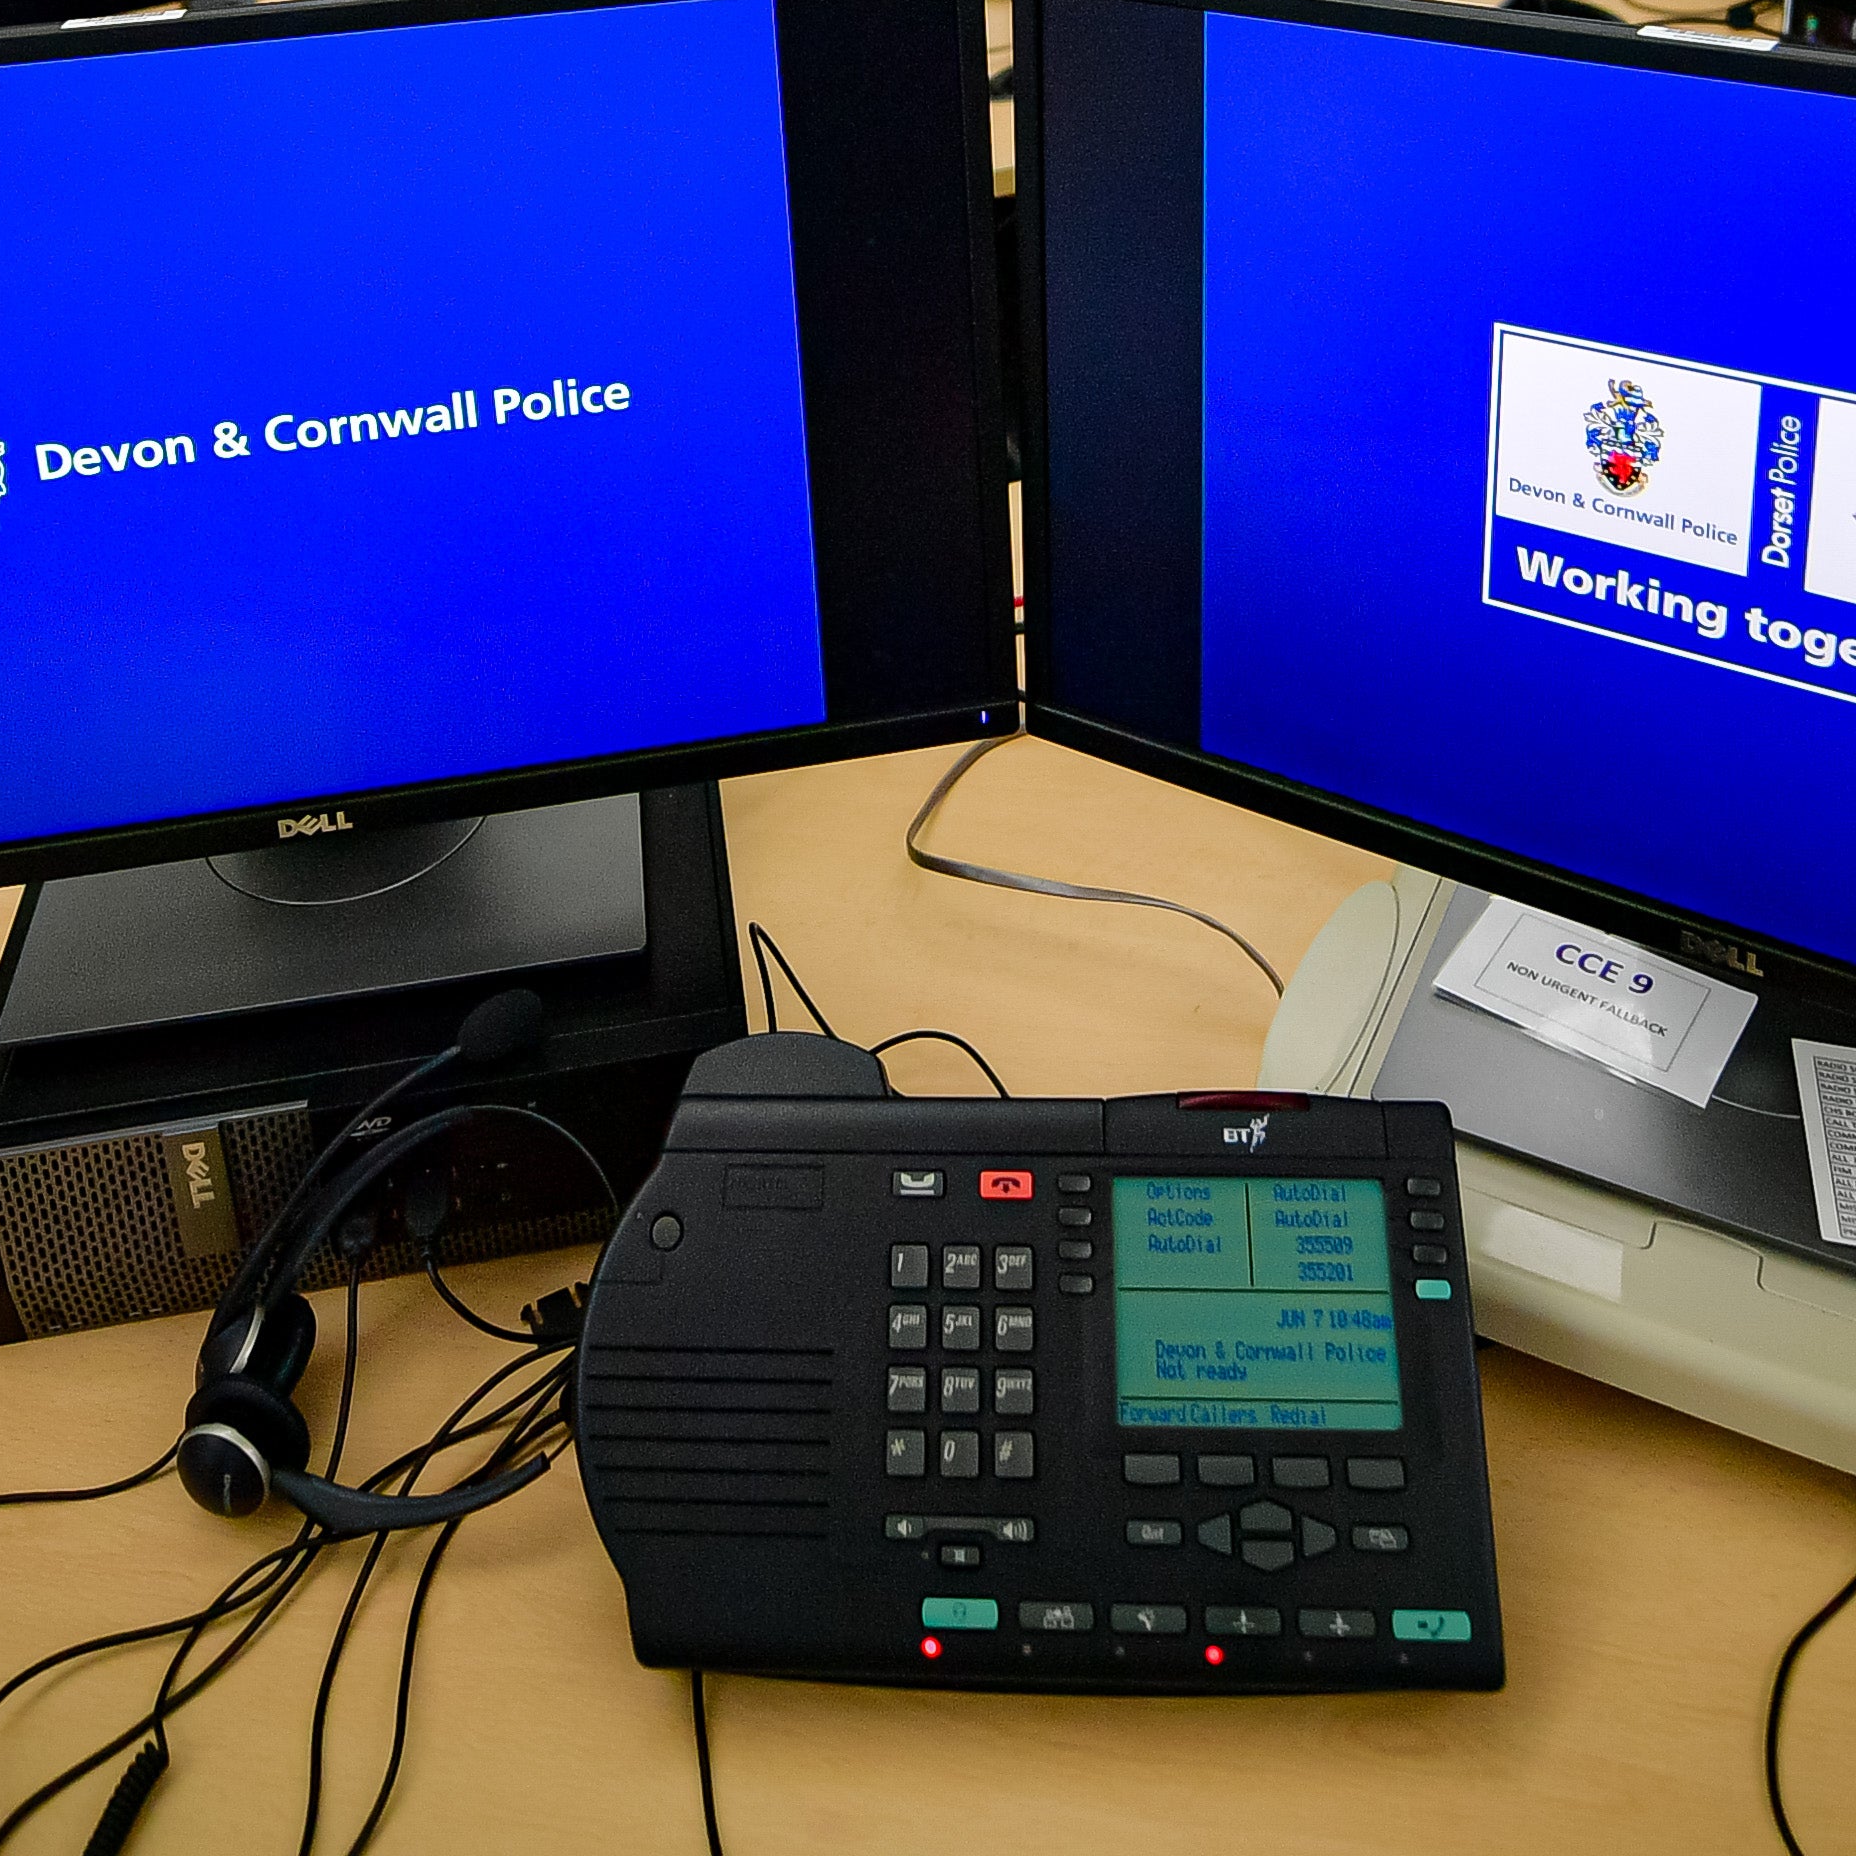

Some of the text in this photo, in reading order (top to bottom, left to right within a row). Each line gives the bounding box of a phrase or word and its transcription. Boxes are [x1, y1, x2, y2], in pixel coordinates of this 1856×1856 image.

[34, 378, 630, 480] Devon & Cornwall Police
[1762, 415, 1802, 568] Dorset Police
[1508, 476, 1738, 546] Devon & Cornwall Police
[1516, 545, 1728, 638] Working
[277, 810, 353, 839] DELL
[1555, 944, 1654, 994] CCE 9
[1507, 961, 1669, 1037] NON URGENT FALLBACK
[1817, 1059, 1847, 1070] RADIO
[1818, 1070, 1849, 1082] RADIO
[1819, 1081, 1851, 1094] RADIO
[1821, 1093, 1853, 1105] RADIO
[1825, 1117, 1850, 1128] CALL
[1223, 1127, 1250, 1144] BT
[182, 1140, 215, 1210] DELL
[1835, 1178, 1853, 1189] ALL
[1273, 1184, 1346, 1202] AutoDial
[1837, 1191, 1855, 1201] ALL
[1275, 1210, 1348, 1228] AutoDial
[1147, 1235, 1222, 1254] AutoDial
[1276, 1309, 1305, 1329] JUN
[1313, 1309, 1323, 1327] 7
[1155, 1340, 1206, 1361] Devon
[1235, 1341, 1313, 1361] Cornwall
[1325, 1342, 1386, 1362] Police
[1156, 1360, 1248, 1381] Not ready
